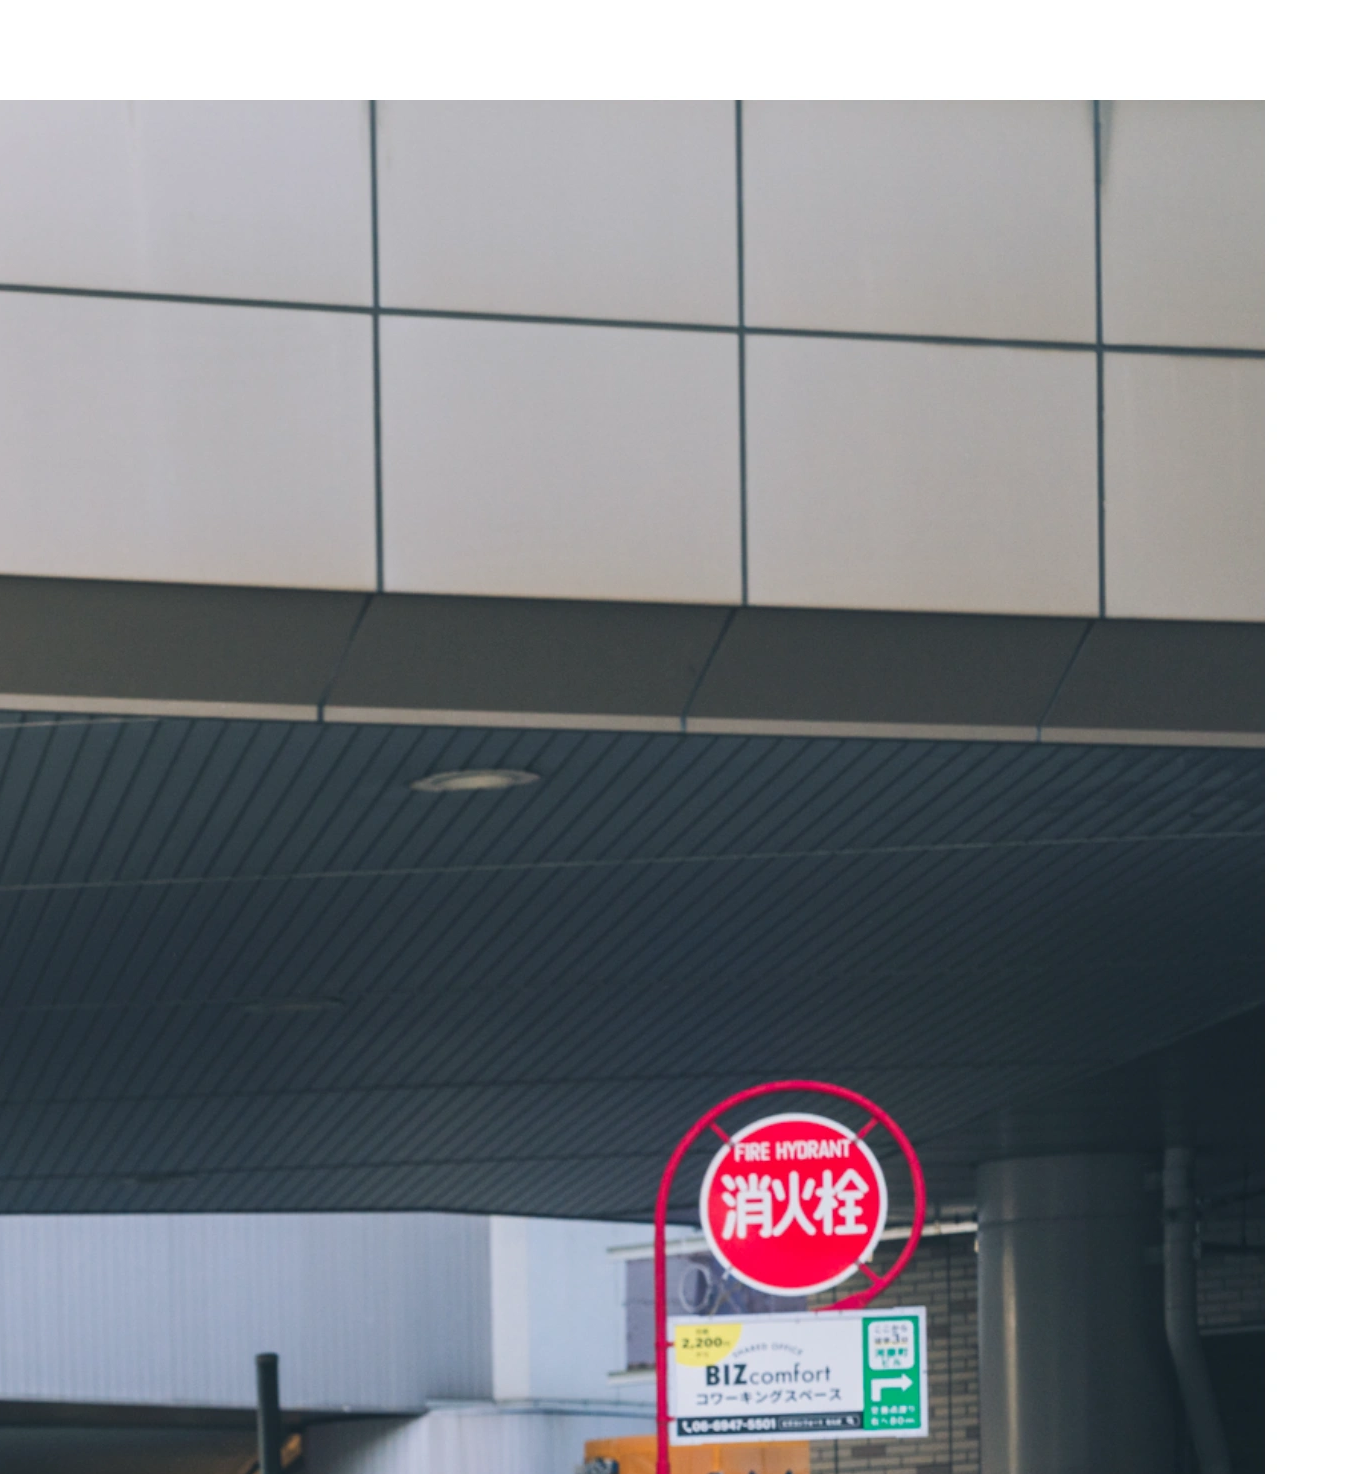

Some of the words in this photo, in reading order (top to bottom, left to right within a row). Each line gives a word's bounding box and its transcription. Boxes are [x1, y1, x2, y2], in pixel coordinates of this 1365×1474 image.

[734, 1142, 770, 1162] FIRE
[775, 1139, 852, 1160] HYDRANT
[721, 1168, 869, 1240] 消火栓
[706, 1362, 831, 1386] BIZcomfort
